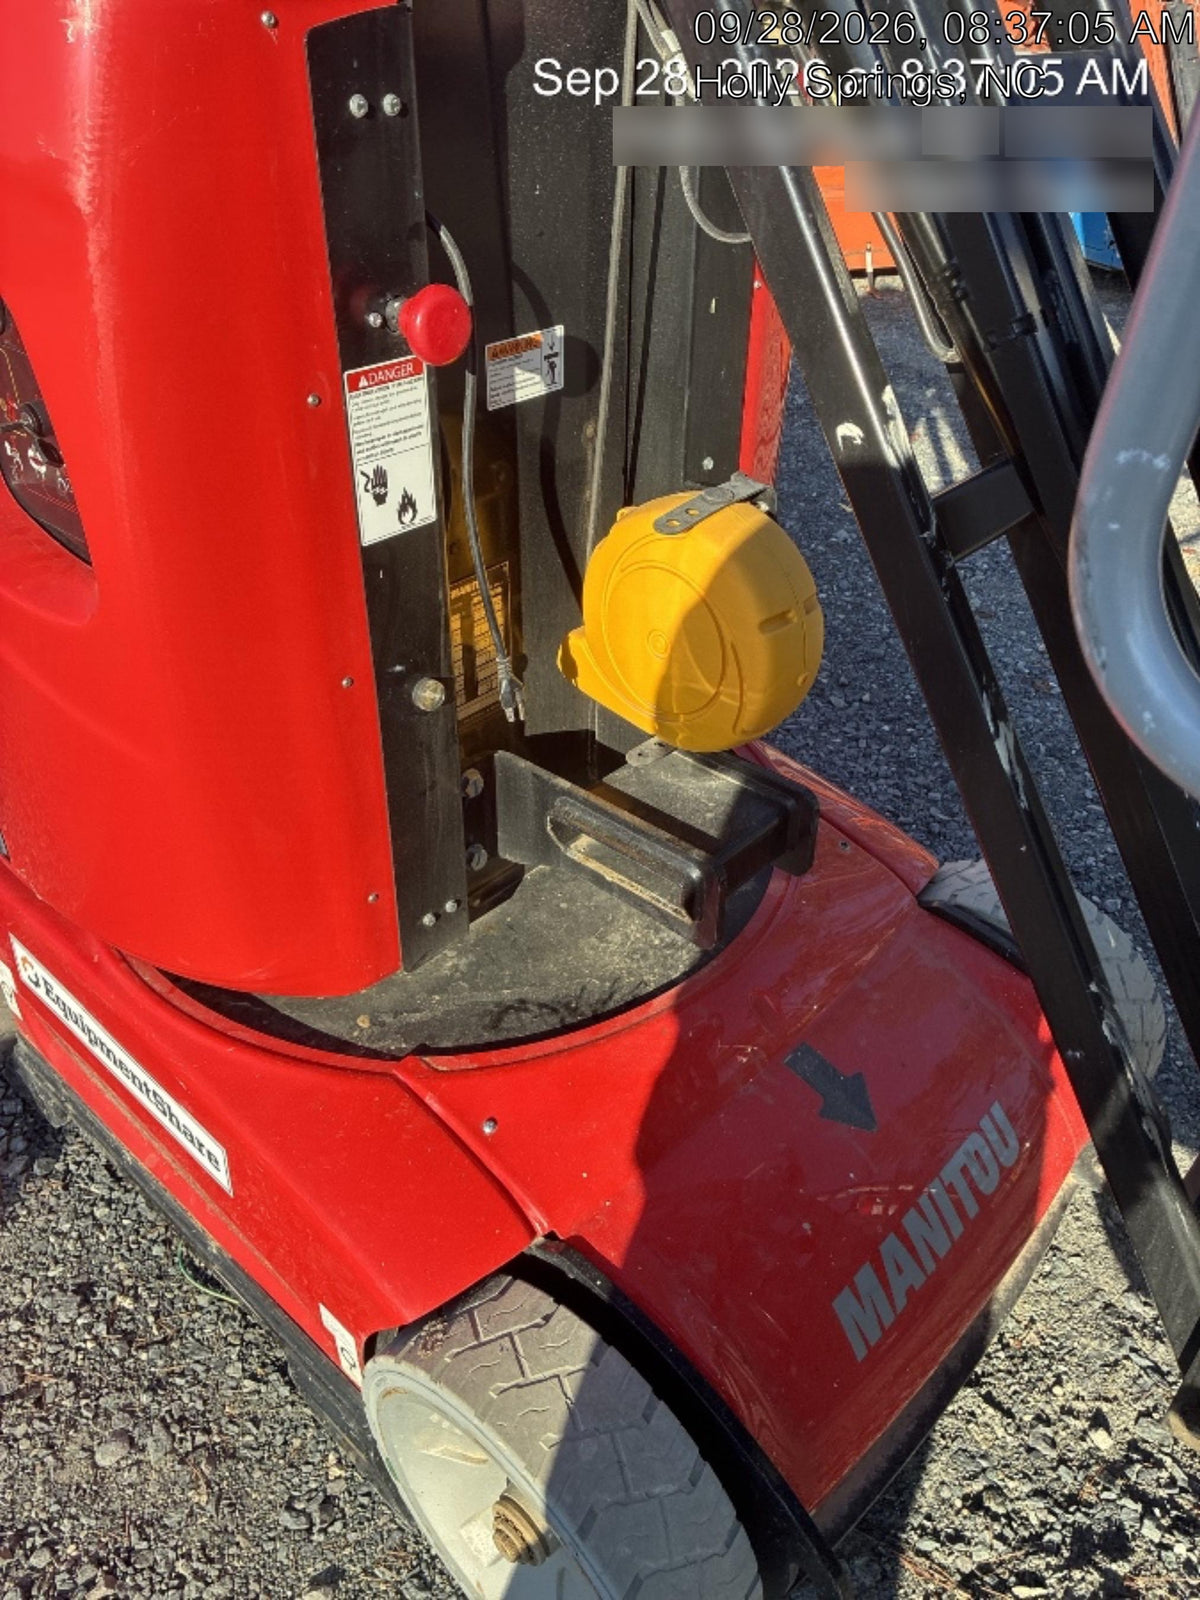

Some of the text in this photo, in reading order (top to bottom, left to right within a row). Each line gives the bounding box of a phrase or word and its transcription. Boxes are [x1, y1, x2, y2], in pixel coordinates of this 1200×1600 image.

[368, 362, 415, 385] DANGER
[42, 976, 223, 1173] EquipmentShare
[832, 1101, 1020, 1363] MANITOU
